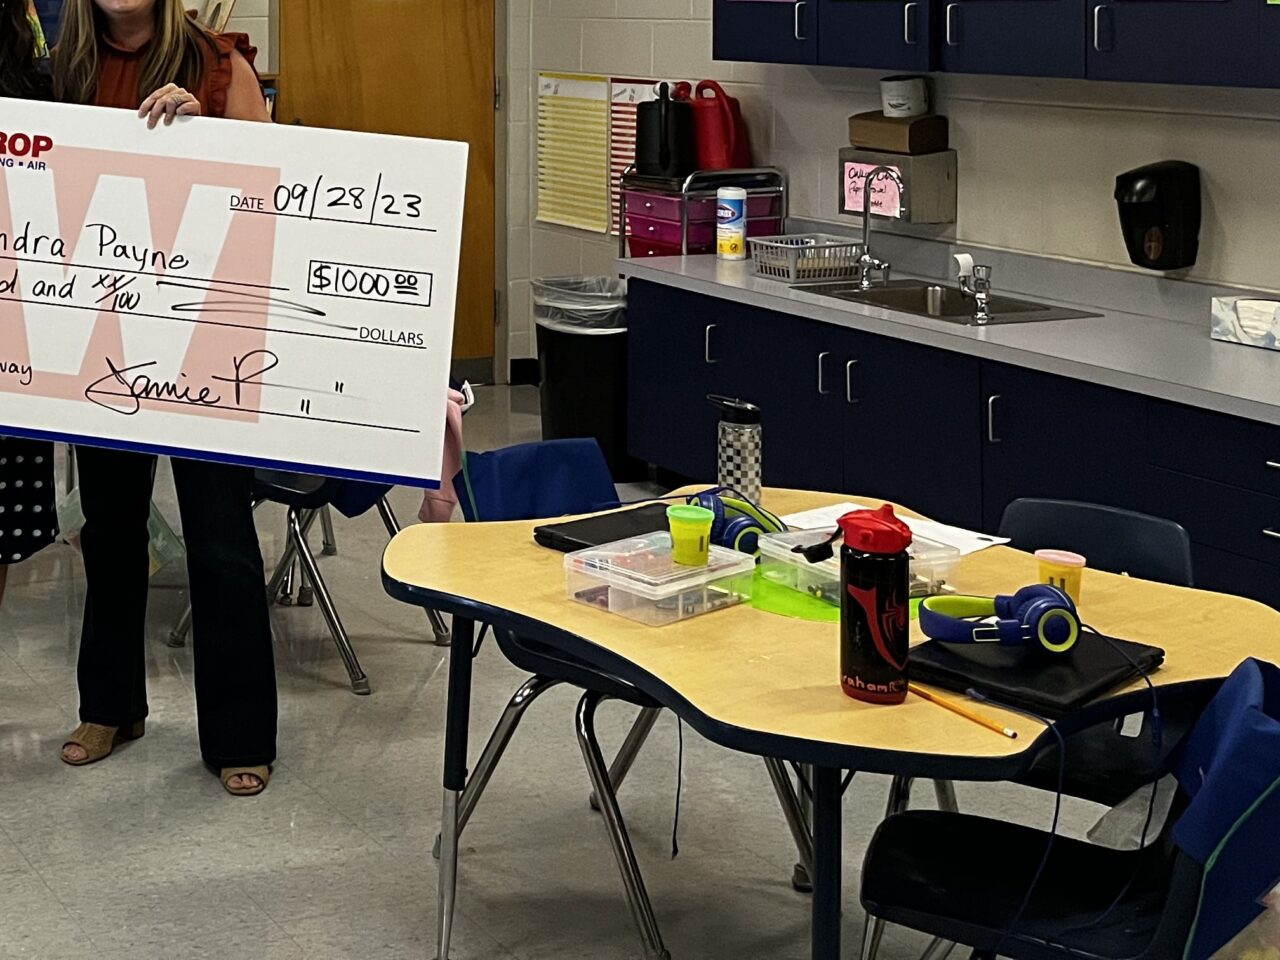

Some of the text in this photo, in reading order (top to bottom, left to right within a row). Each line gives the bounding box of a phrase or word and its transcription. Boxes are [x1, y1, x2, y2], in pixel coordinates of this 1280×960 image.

[26, 159, 47, 171] AIR
[230, 195, 265, 211] DATE
[273, 173, 423, 225] 09/28/23
[85, 223, 190, 271] Payne
[32, 277, 74, 300] and
[358, 327, 425, 346] DOLLARS
